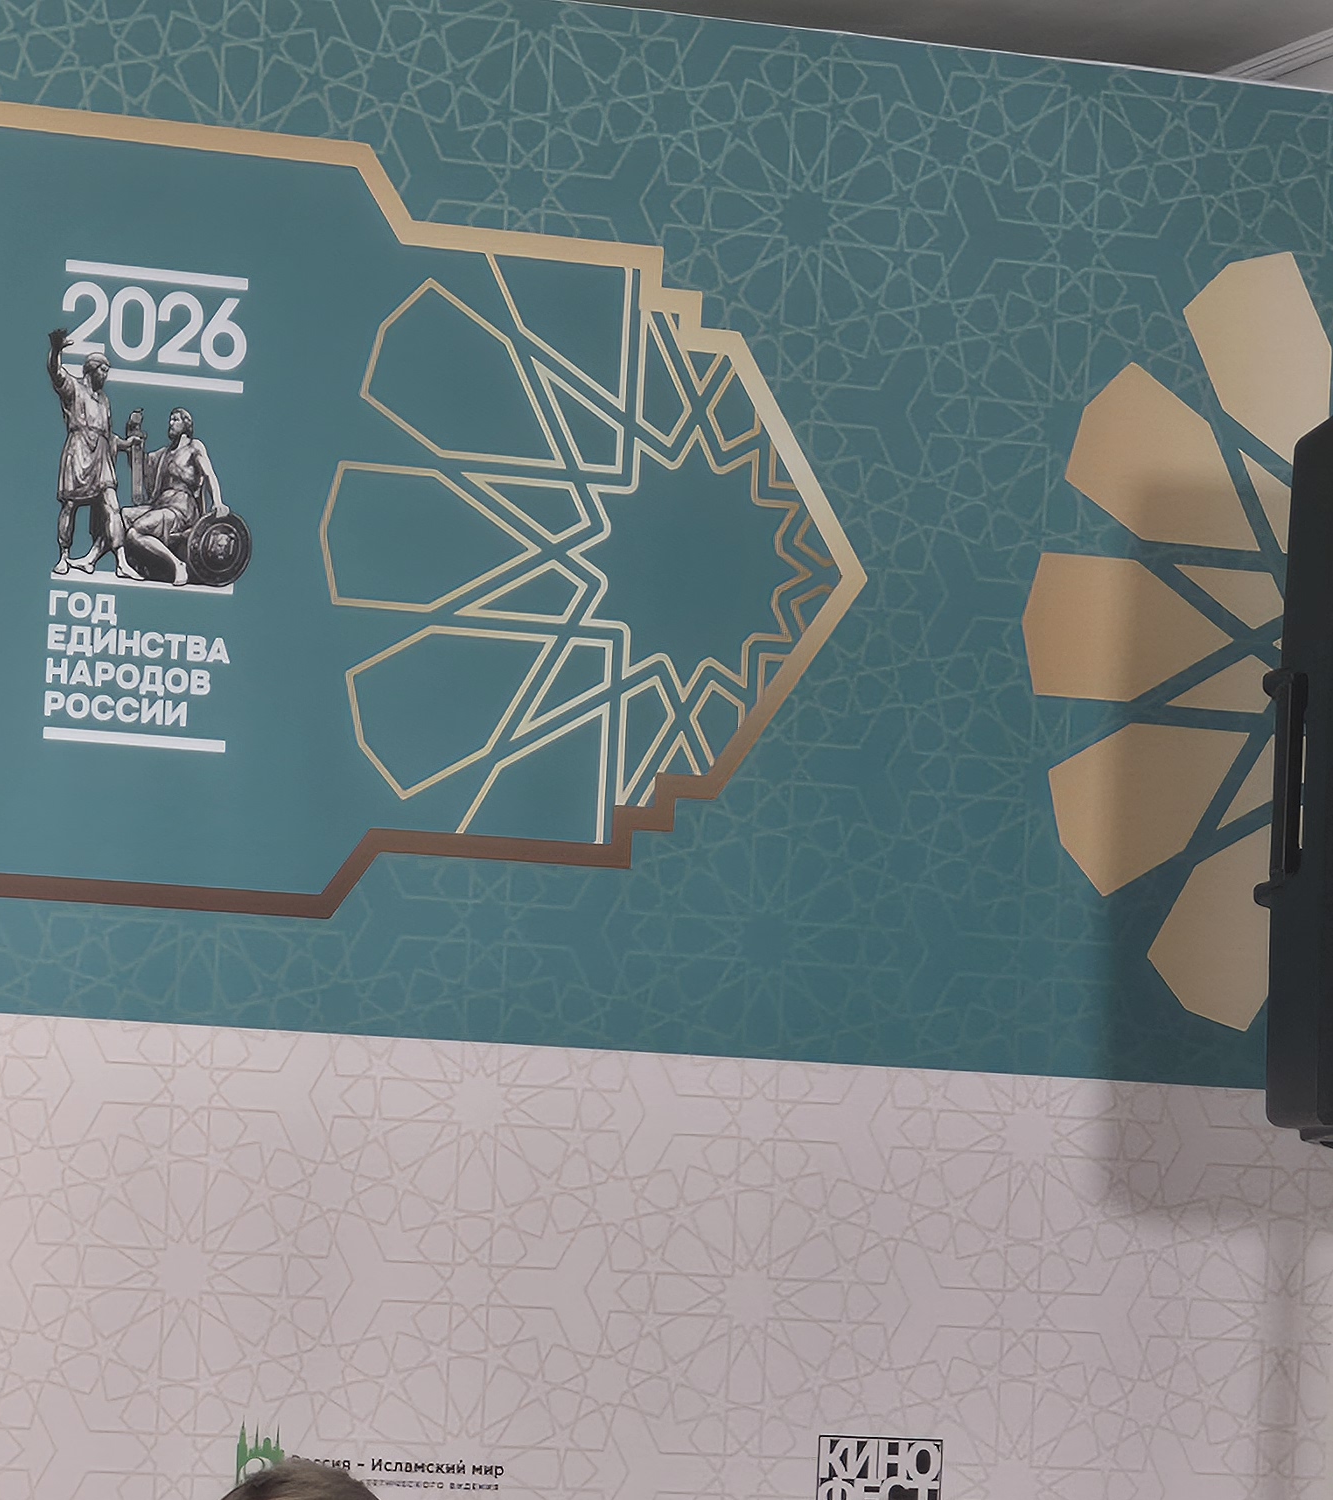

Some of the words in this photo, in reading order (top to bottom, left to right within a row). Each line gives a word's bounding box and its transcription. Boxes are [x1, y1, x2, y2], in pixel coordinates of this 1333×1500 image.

[62, 281, 247, 371] 2026
[48, 590, 117, 626] ГОД
[46, 624, 230, 664] ЕДИНСТВА
[45, 658, 210, 697] НАРОДОВ
[43, 691, 188, 727] РОССИИ
[371, 1458, 466, 1475] Исламский
[472, 1464, 504, 1479] мир
[820, 1438, 941, 1480] КИНО
